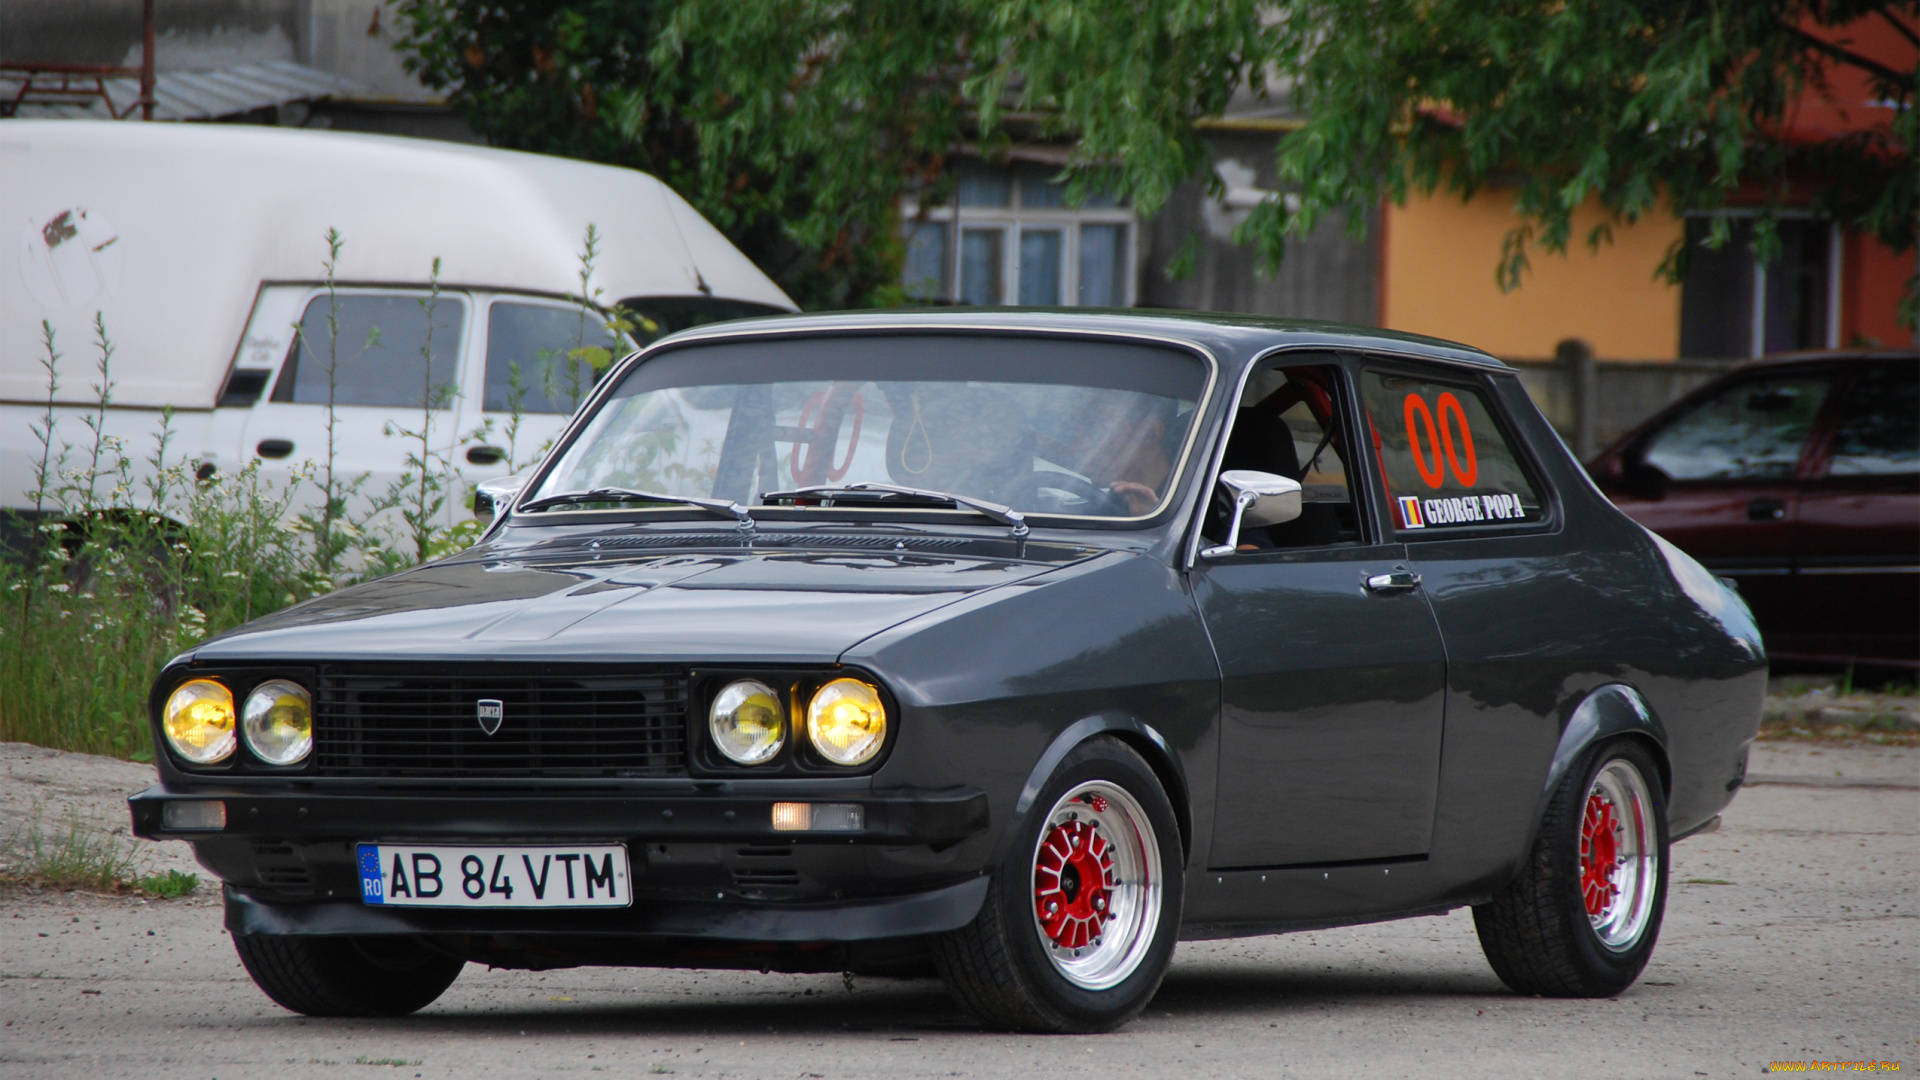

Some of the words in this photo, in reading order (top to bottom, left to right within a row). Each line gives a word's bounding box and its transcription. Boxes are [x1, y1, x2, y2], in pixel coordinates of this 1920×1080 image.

[1404, 392, 1478, 489] 00
[1424, 495, 1484, 524] GEORGE
[1482, 493, 1525, 520] POPA
[364, 878, 382, 897] RO
[390, 853, 444, 898] AB
[460, 854, 514, 900] 84
[522, 853, 617, 900] VTM
